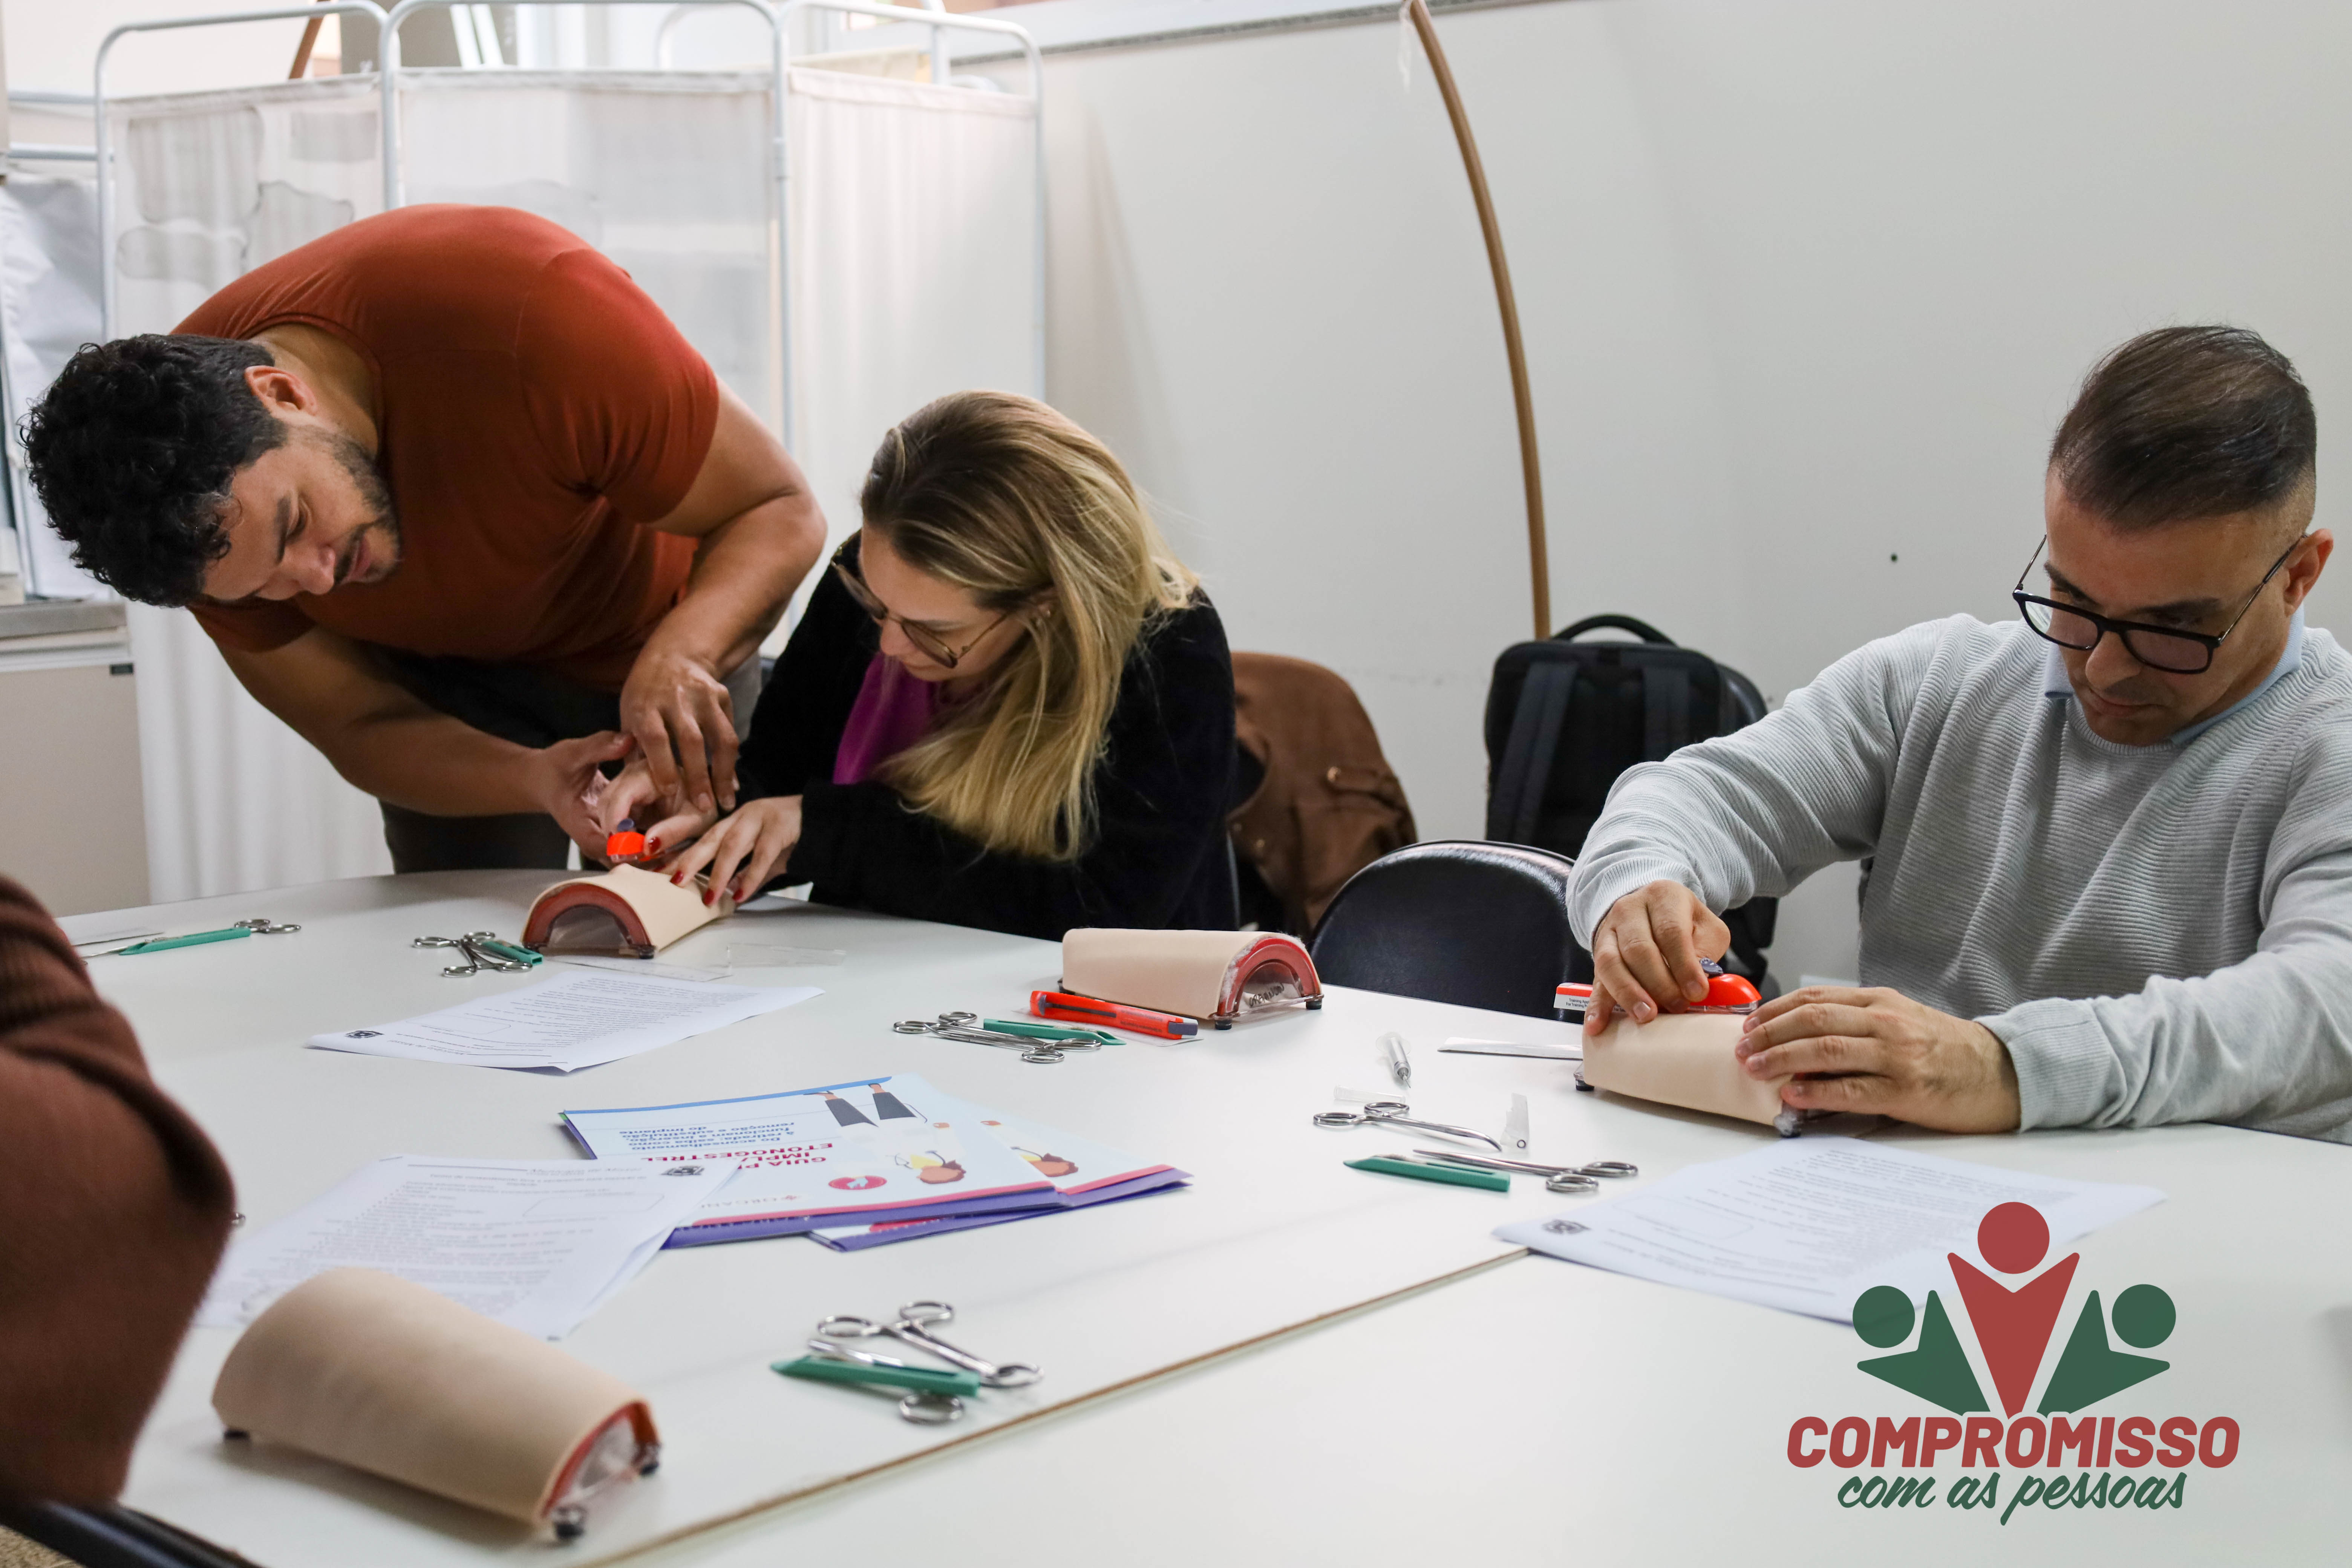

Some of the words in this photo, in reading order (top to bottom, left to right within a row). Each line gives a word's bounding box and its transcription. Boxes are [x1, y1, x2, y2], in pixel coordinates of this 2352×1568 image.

[731, 1122, 794, 1131] remoção
[622, 1130, 714, 1139] substituição
[712, 1127, 790, 1136] funcionam
[632, 1139, 756, 1150] aconselhamento
[641, 1143, 833, 1161] ETONOGESTREL
[768, 1157, 826, 1166] GUIA
